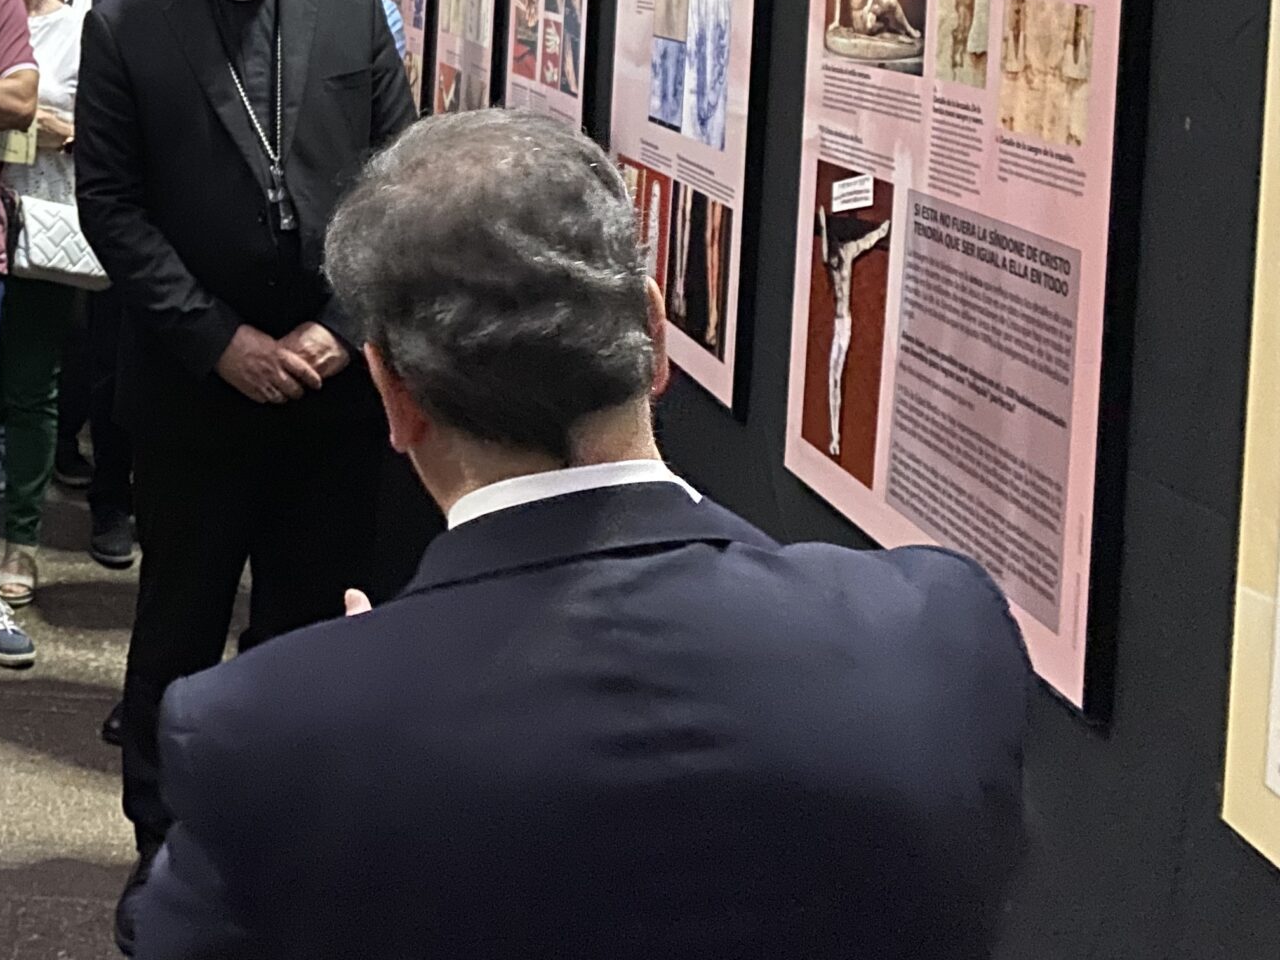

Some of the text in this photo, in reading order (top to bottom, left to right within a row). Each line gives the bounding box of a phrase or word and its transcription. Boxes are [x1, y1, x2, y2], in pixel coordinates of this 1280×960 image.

[940, 211, 951, 229] NO
[1026, 244, 1039, 264] DE
[1039, 250, 1072, 276] CRISTO
[945, 232, 961, 252] QUE
[1043, 272, 1070, 297] TODO
